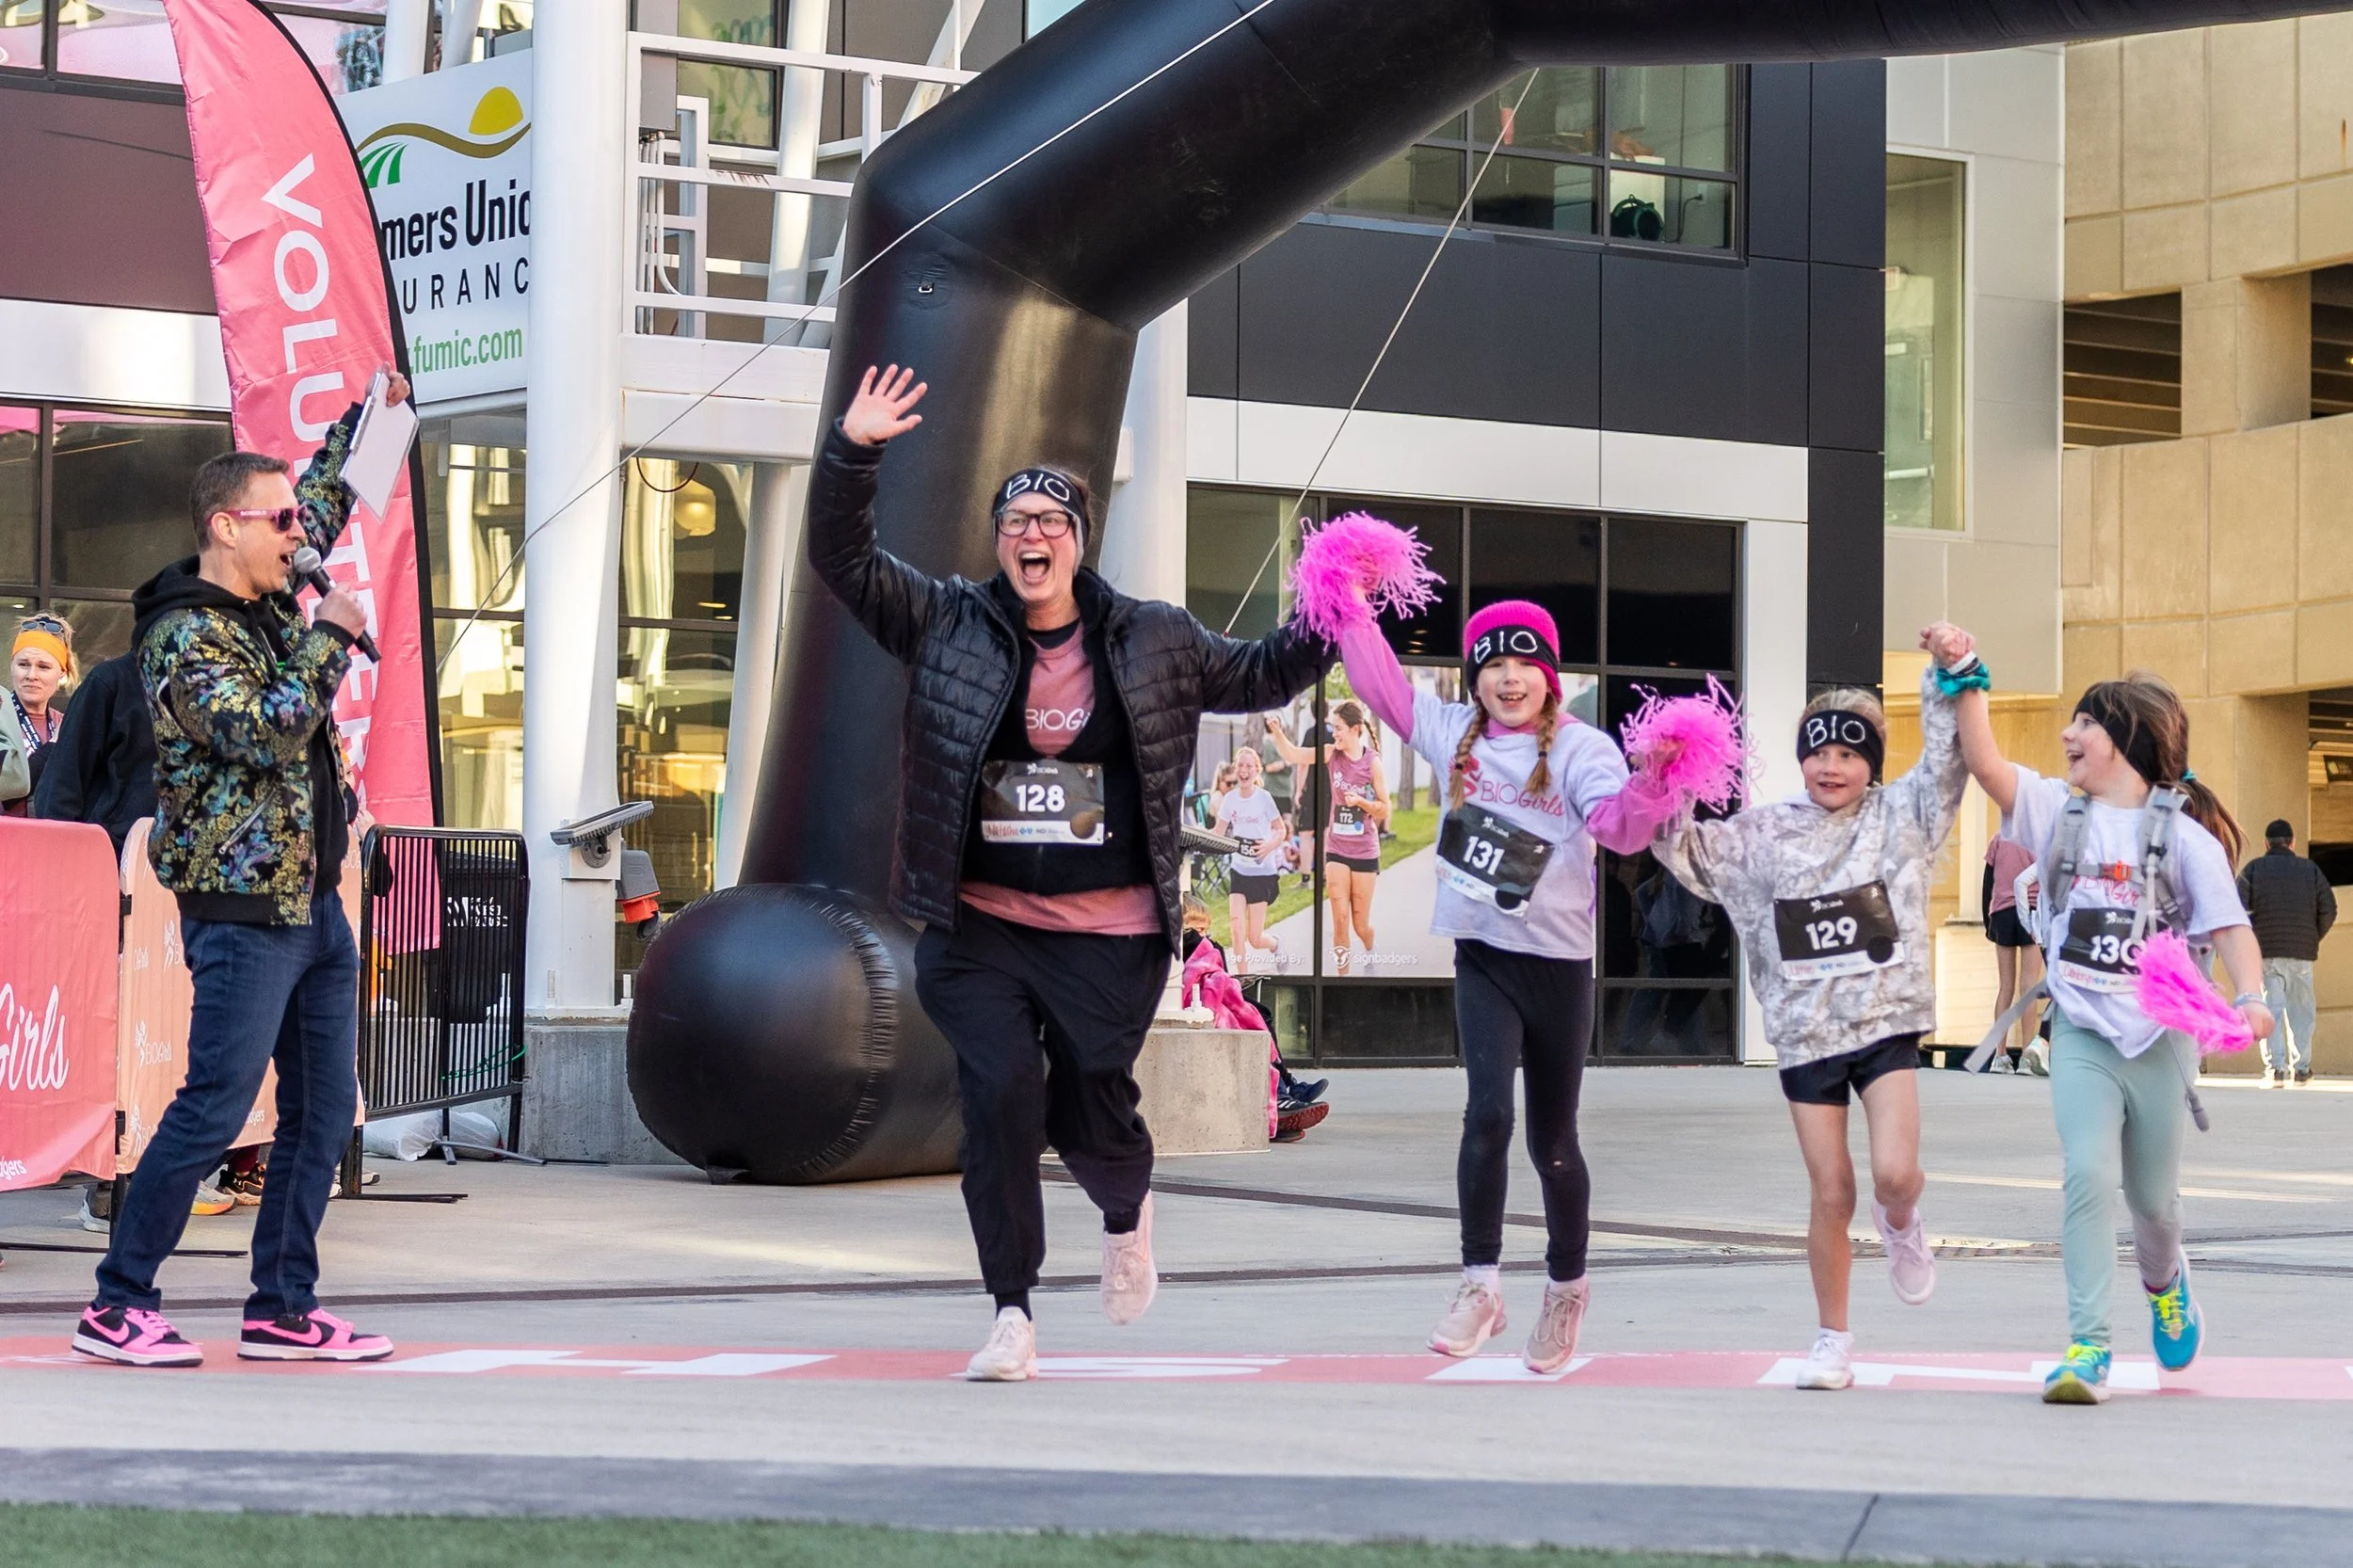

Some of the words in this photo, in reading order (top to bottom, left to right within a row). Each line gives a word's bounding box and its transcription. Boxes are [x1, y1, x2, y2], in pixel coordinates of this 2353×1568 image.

[408, 328, 522, 375] .fumic.com
[1006, 473, 1070, 502] BIO
[1474, 631, 1538, 664] BIO
[1806, 715, 1865, 747] BIO
[1016, 784, 1065, 812] 128
[1339, 812, 1353, 824] 172
[1463, 836, 1505, 876] 131
[1805, 916, 1858, 951] 129
[1225, 954, 1243, 965] ge
[1245, 953, 1287, 964] Provided
[1290, 954, 1305, 966] By:
[1354, 952, 1417, 966] signbadgers
[2090, 935, 2144, 966] 130
